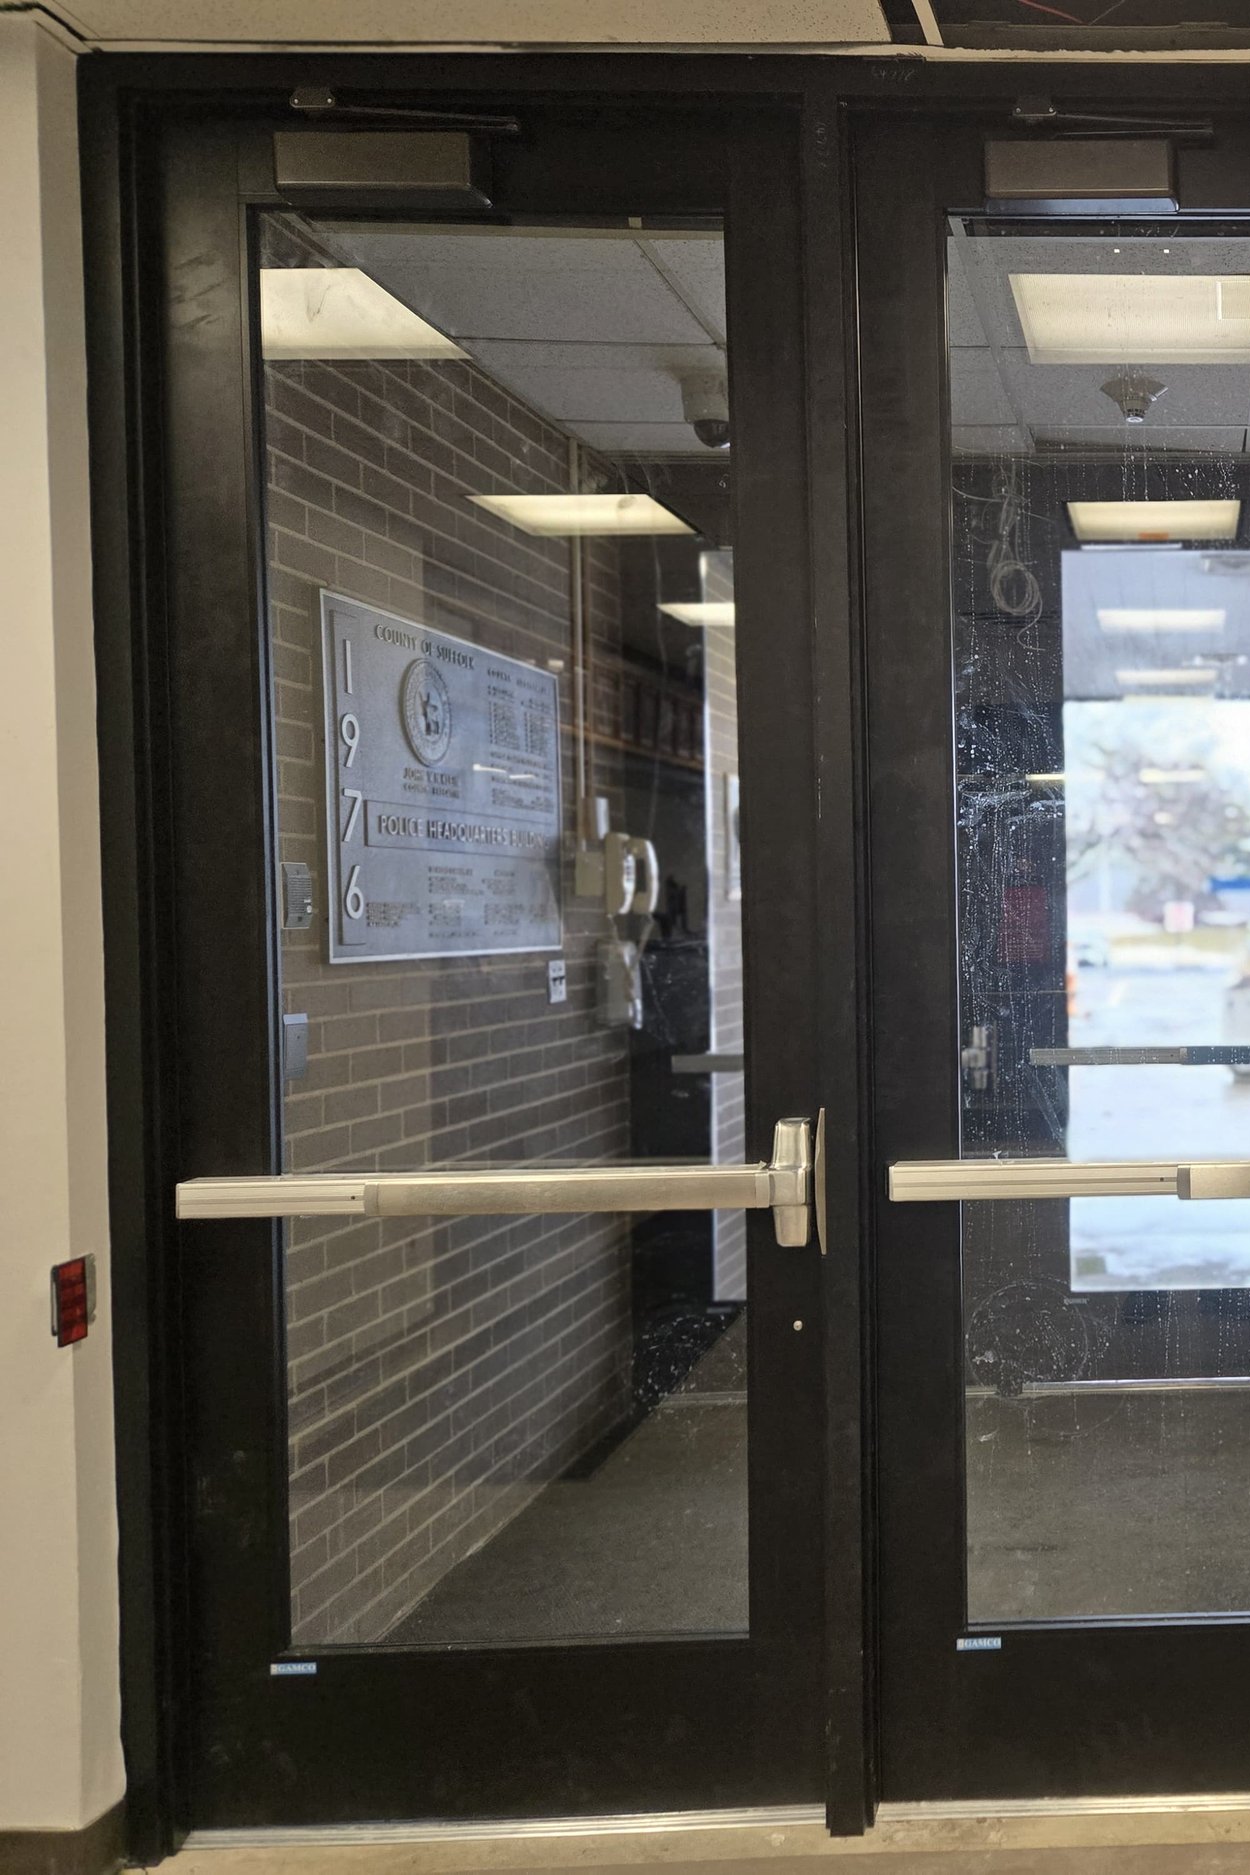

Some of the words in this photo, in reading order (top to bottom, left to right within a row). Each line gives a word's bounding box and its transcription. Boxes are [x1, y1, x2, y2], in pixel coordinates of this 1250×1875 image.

[374, 623, 416, 652] COUNTY
[420, 639, 433, 657] OF
[377, 814, 424, 838] POLICE
[427, 819, 509, 846] HEADQUARTERS
